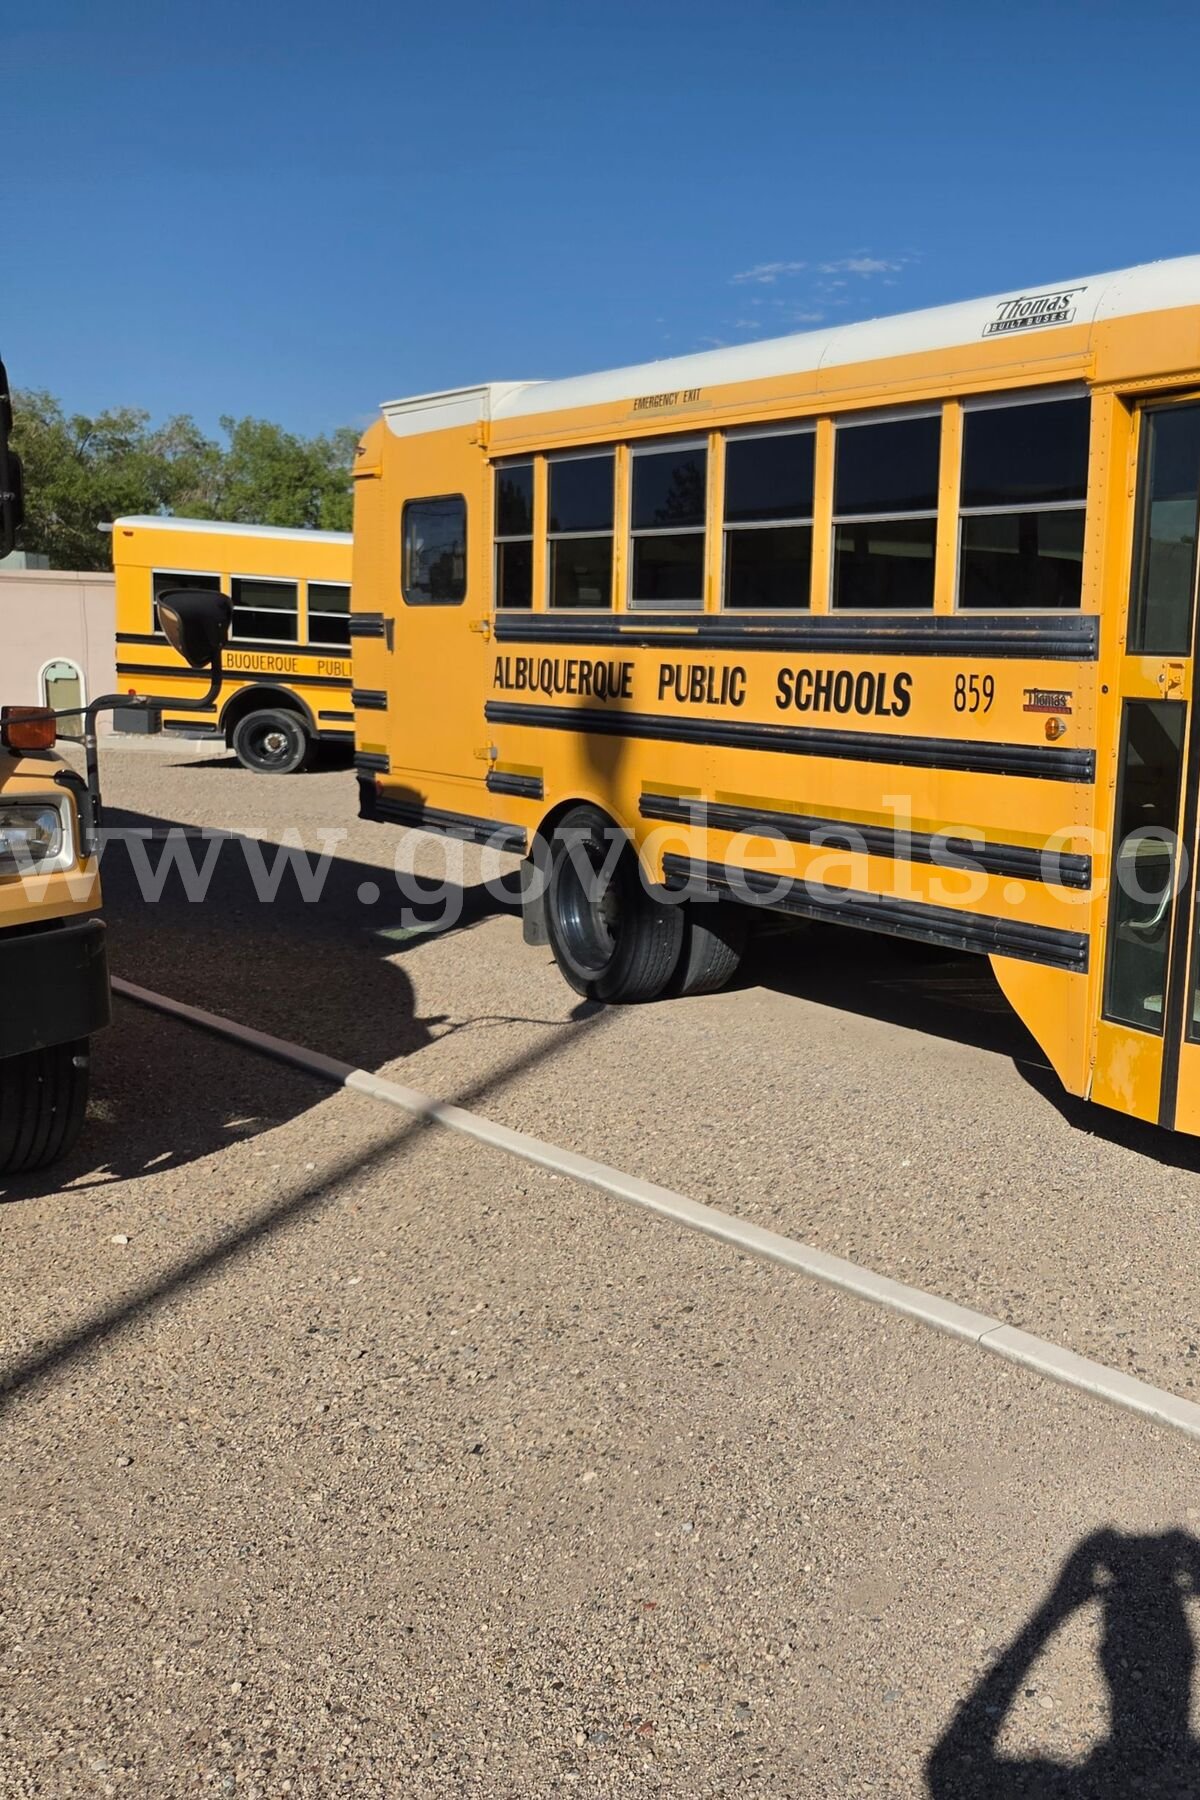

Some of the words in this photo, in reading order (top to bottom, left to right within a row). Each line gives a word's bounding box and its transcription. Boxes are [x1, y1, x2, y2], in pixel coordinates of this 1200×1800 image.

[997, 286, 1088, 321] Thomas
[991, 319, 1023, 332] BUILT
[1027, 312, 1066, 326] BUSES
[633, 392, 680, 410] EMERGENCY
[683, 388, 702, 402] EXIT
[223, 653, 299, 673] BUQUERQUE
[318, 660, 353, 677] PUBLI
[493, 656, 636, 702] ALBUQUERQUE
[657, 664, 747, 707] PUBLIC
[775, 668, 913, 717] SCHOOLS
[954, 673, 996, 713] 859
[1023, 688, 1073, 706] Thomas
